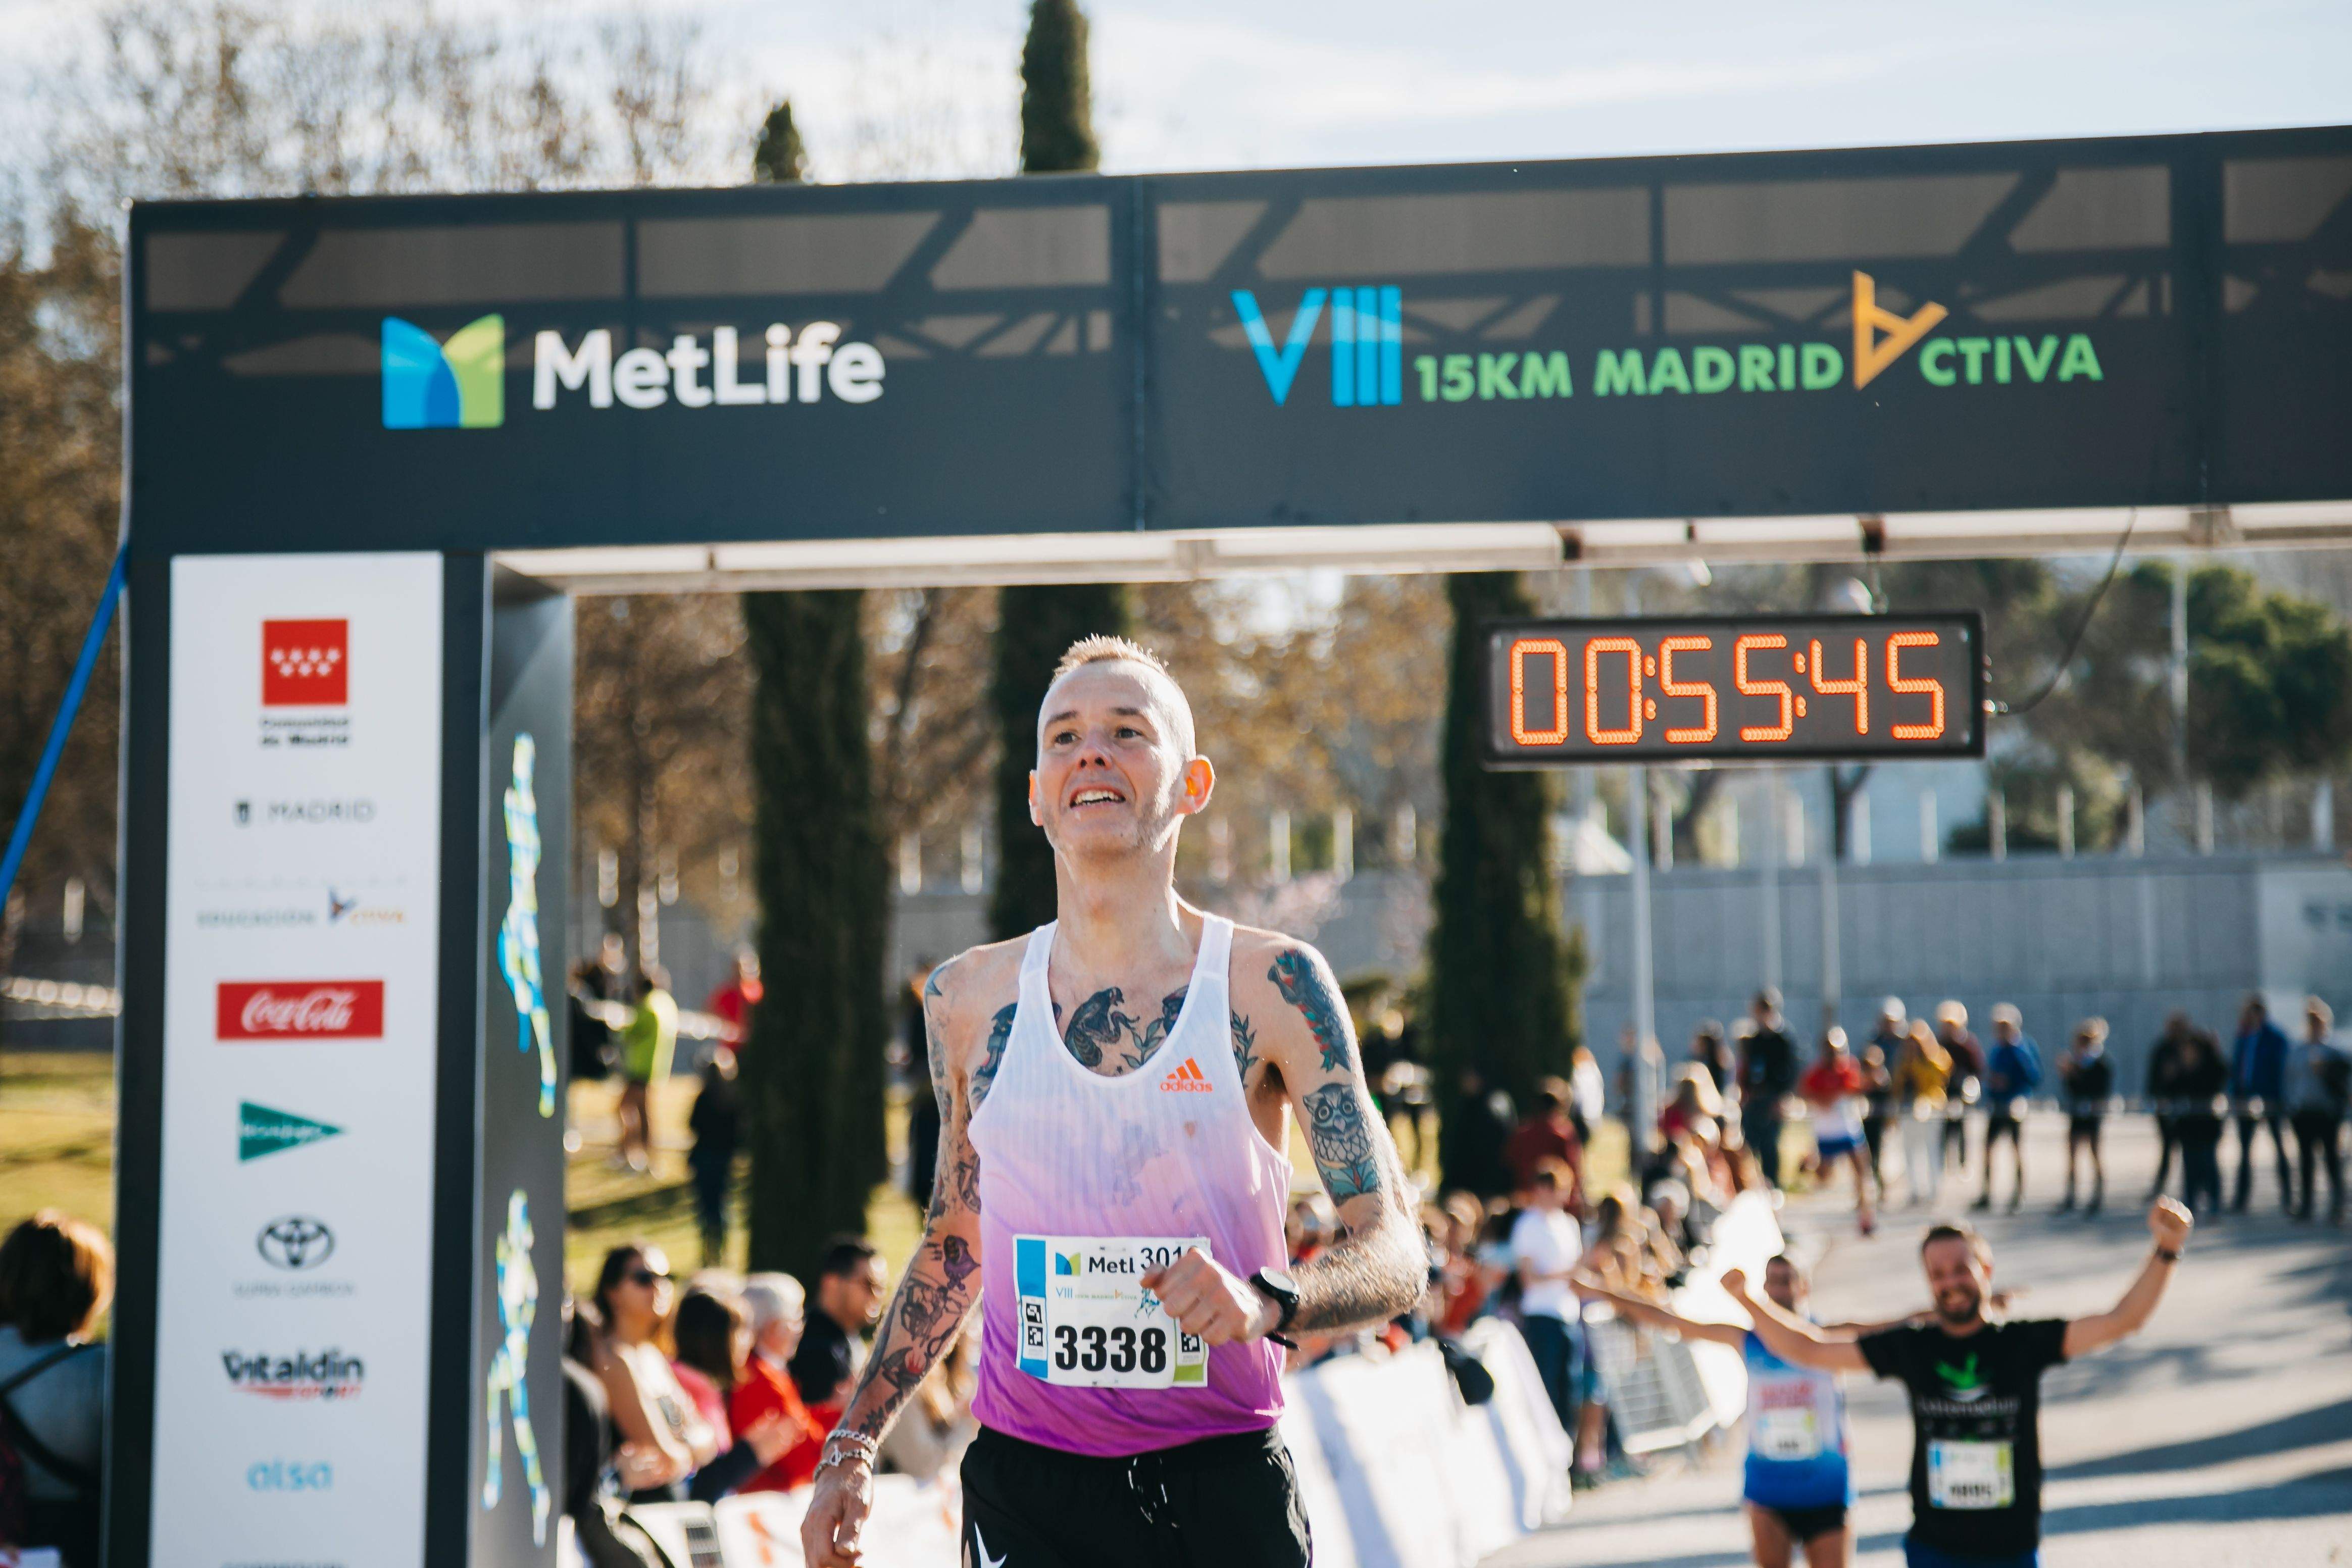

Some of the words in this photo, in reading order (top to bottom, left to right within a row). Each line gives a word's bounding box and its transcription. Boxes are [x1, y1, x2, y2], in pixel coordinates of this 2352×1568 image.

[532, 321, 887, 411] MetLife
[1231, 285, 1403, 407] VIII
[1415, 351, 1573, 402] 15KM
[1594, 343, 1844, 396] MADRID
[1511, 632, 1944, 745] 00:55:45
[266, 799, 375, 823] MADRID
[1160, 1080, 1213, 1092] adidas
[222, 1348, 365, 1384] Vitaldin
[1054, 1325, 1167, 1374] 3338
[247, 1458, 332, 1491] alsa
